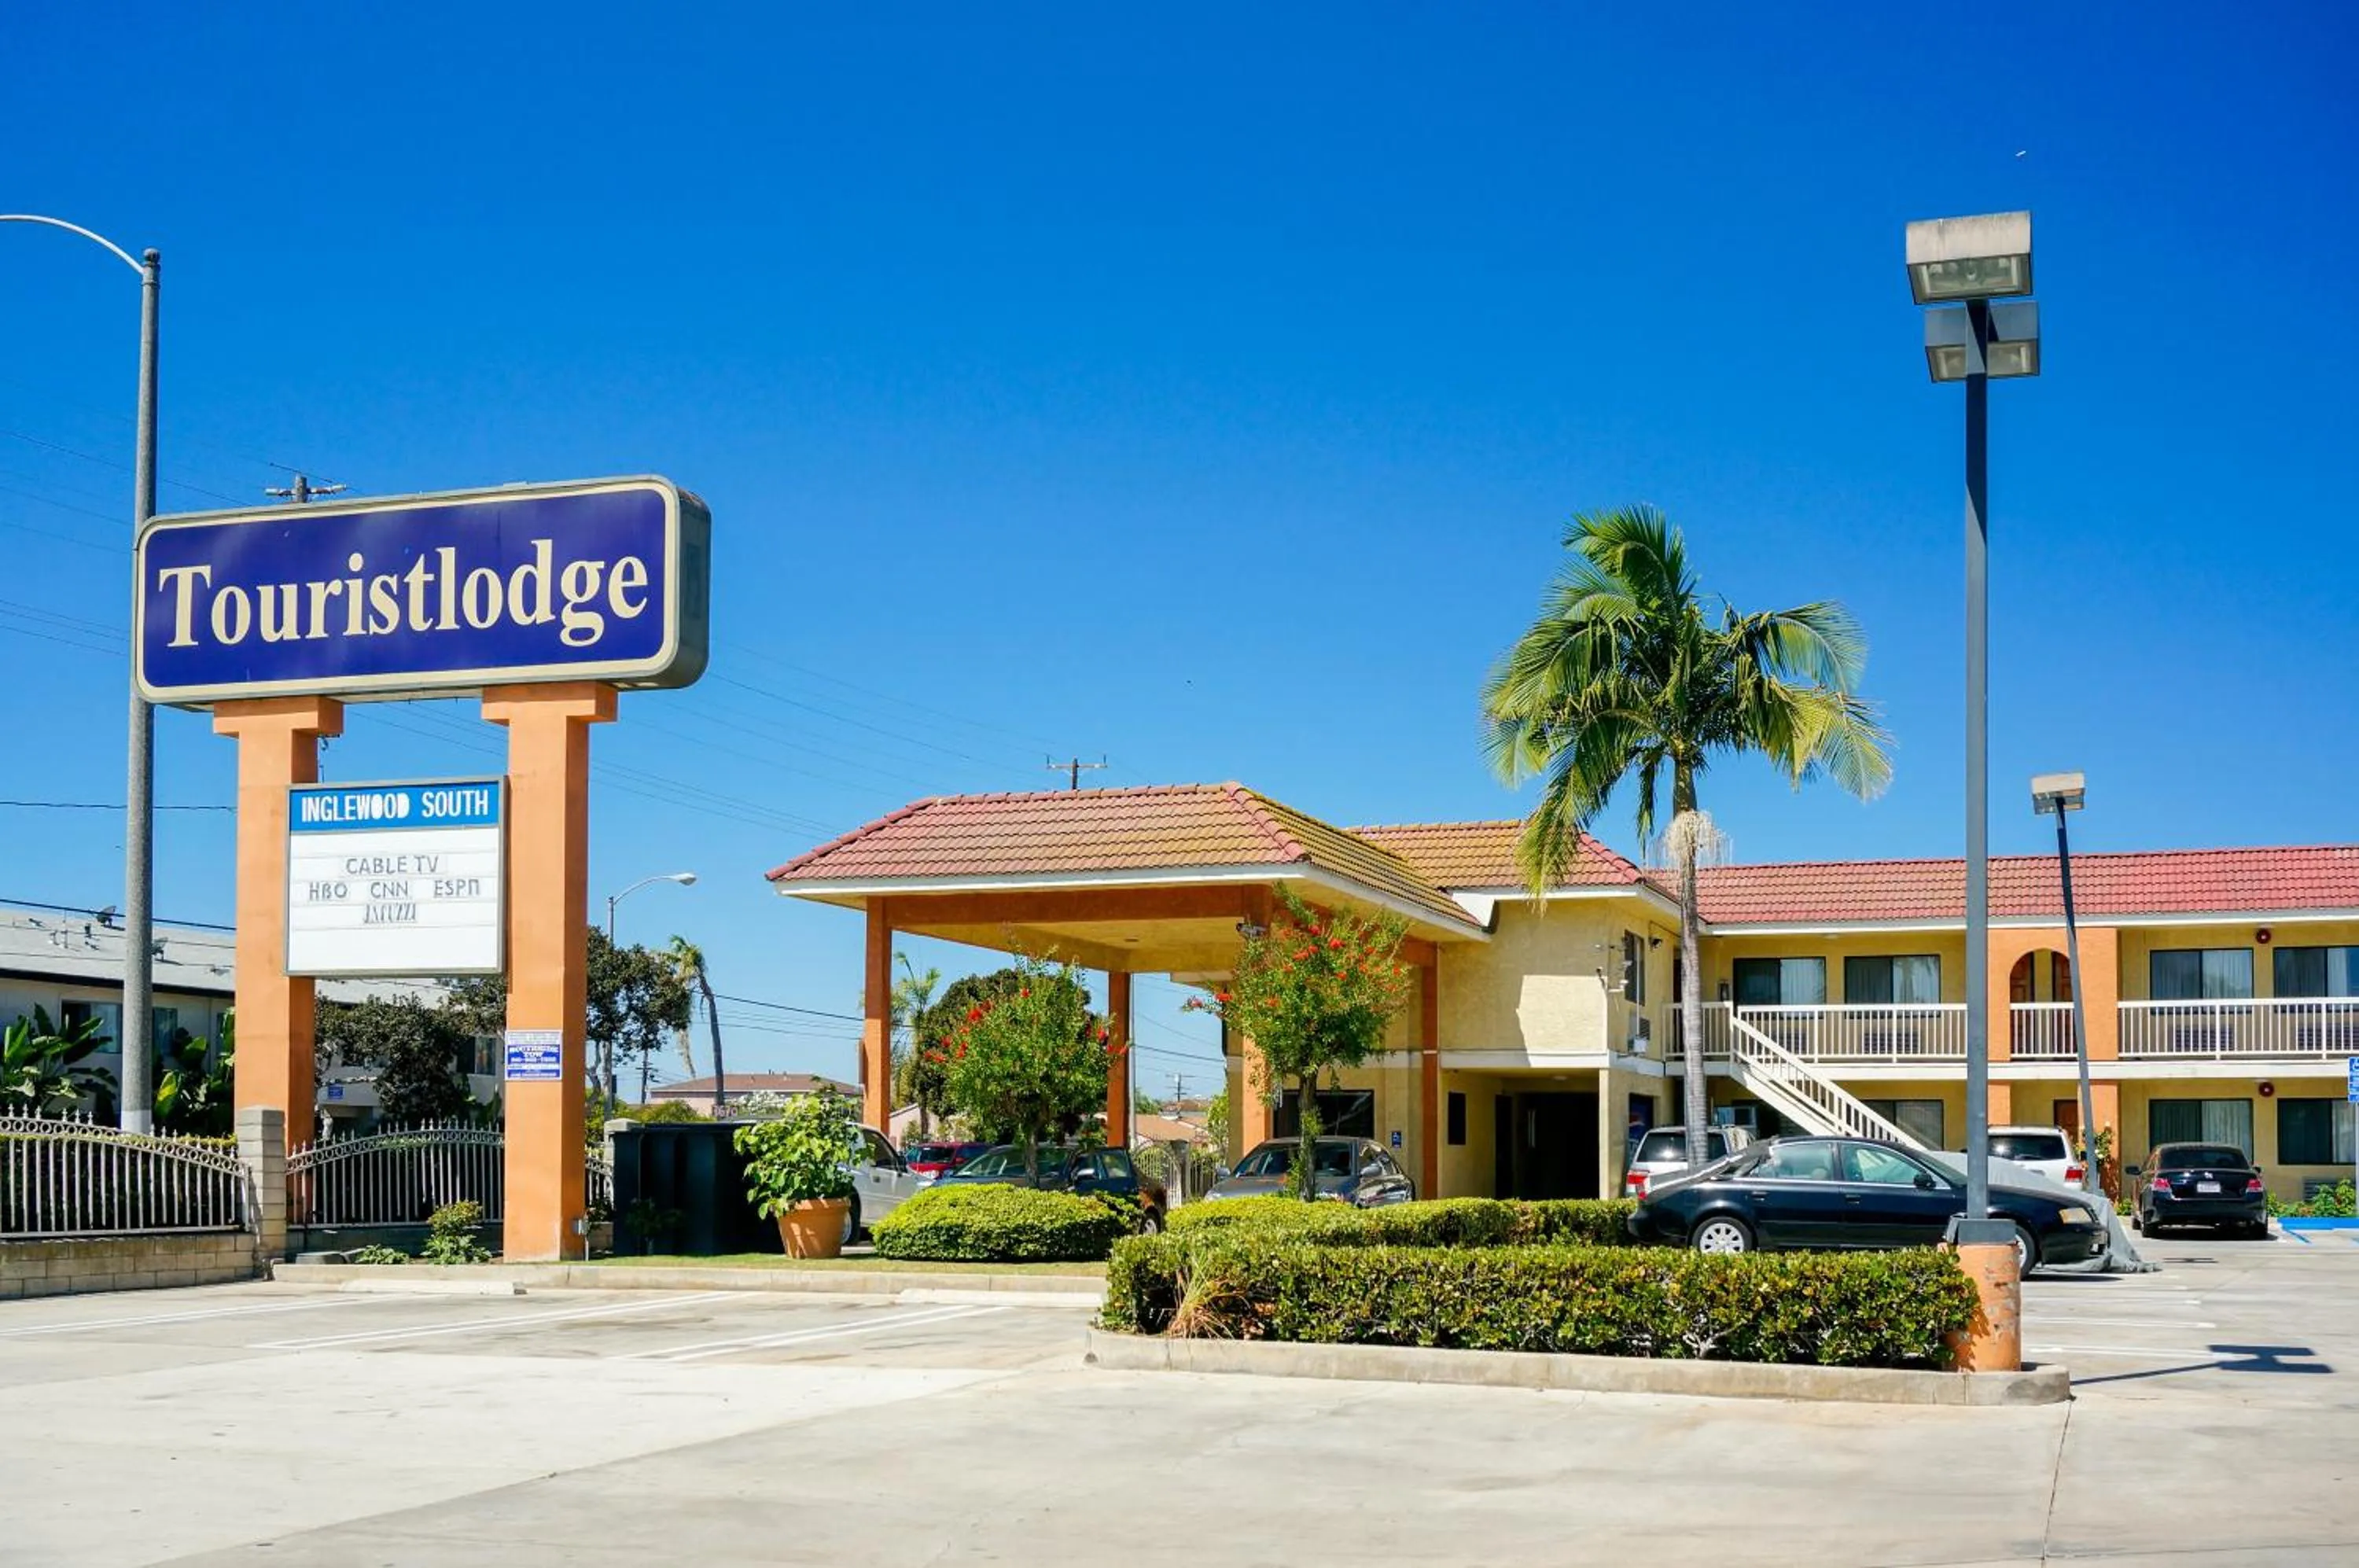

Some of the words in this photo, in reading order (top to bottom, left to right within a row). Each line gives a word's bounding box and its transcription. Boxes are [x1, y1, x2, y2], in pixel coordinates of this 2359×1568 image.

[158, 539, 648, 647] Touristlodge
[301, 792, 410, 823] INGLEWOOD
[421, 789, 488, 818] SOUTH
[345, 856, 407, 875] CABLE
[414, 854, 440, 874] TV
[309, 881, 348, 901] HBO
[370, 880, 409, 900] CNN
